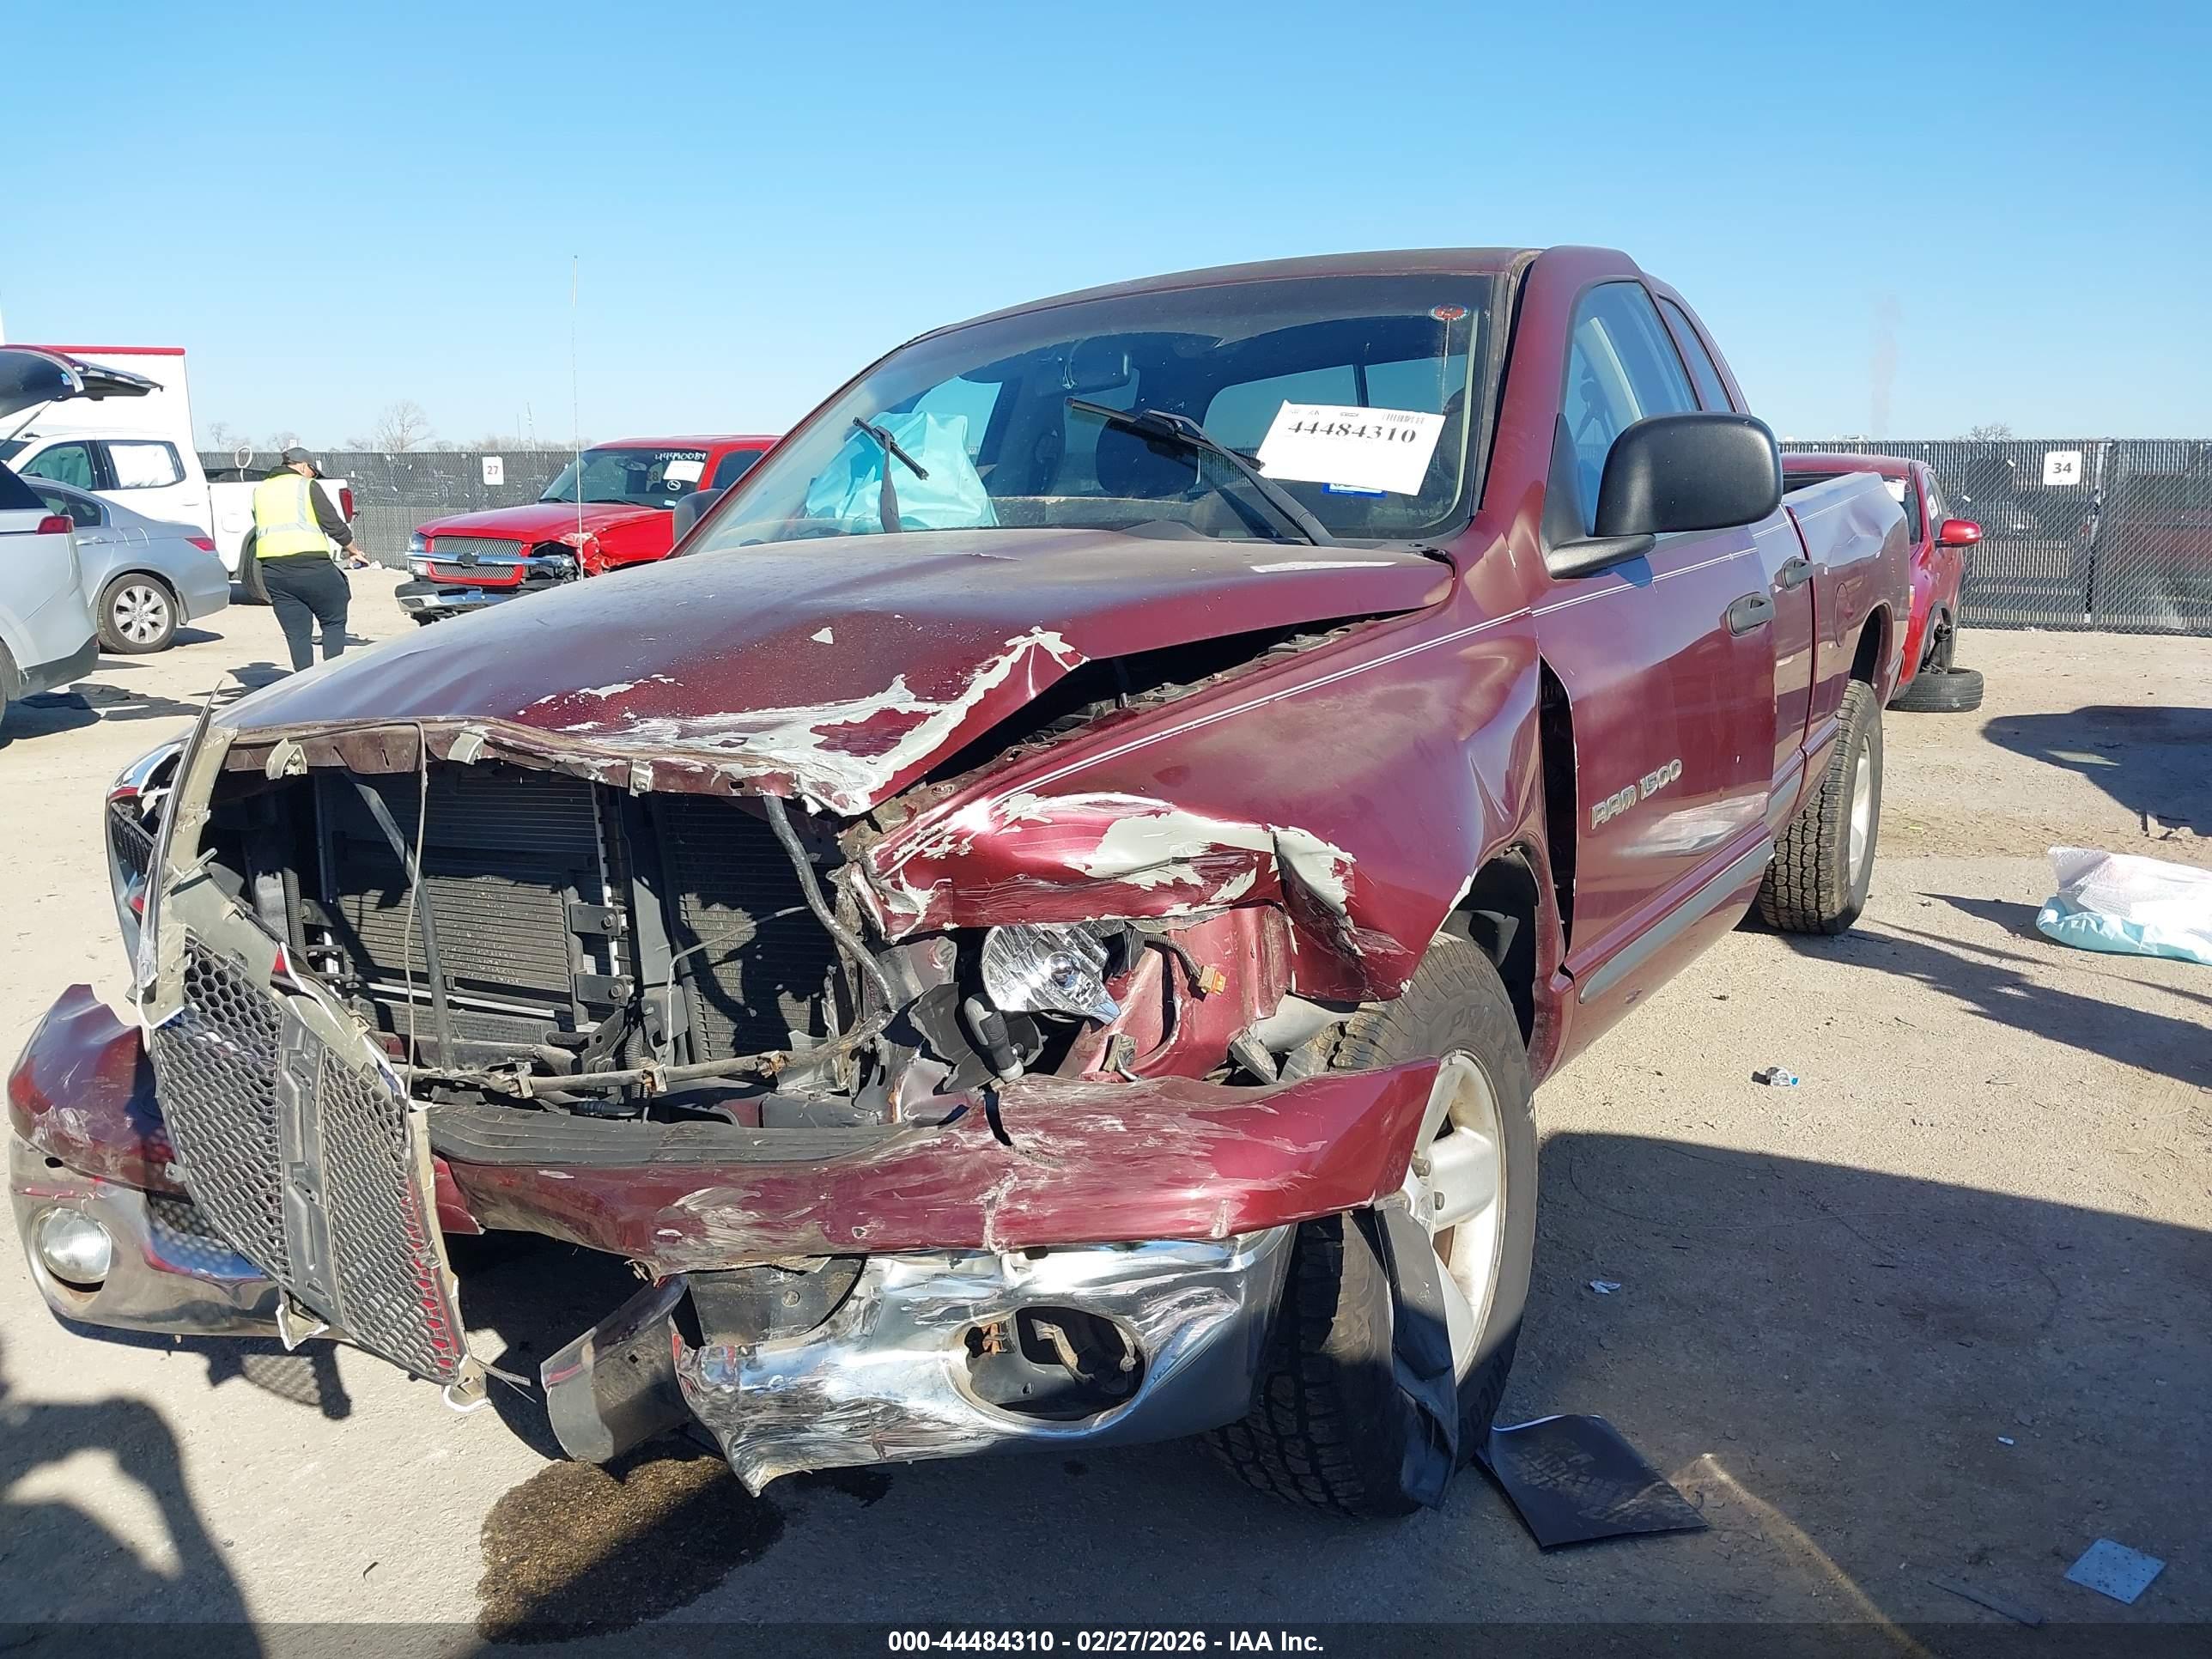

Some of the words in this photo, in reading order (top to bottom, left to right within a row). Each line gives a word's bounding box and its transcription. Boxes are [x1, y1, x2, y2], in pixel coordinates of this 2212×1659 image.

[1288, 420, 1417, 444] 44484310
[487, 465, 499, 475] 27
[2052, 462, 2072, 474] 34
[1590, 784, 1638, 830] RAM
[1638, 757, 1684, 800] 1500
